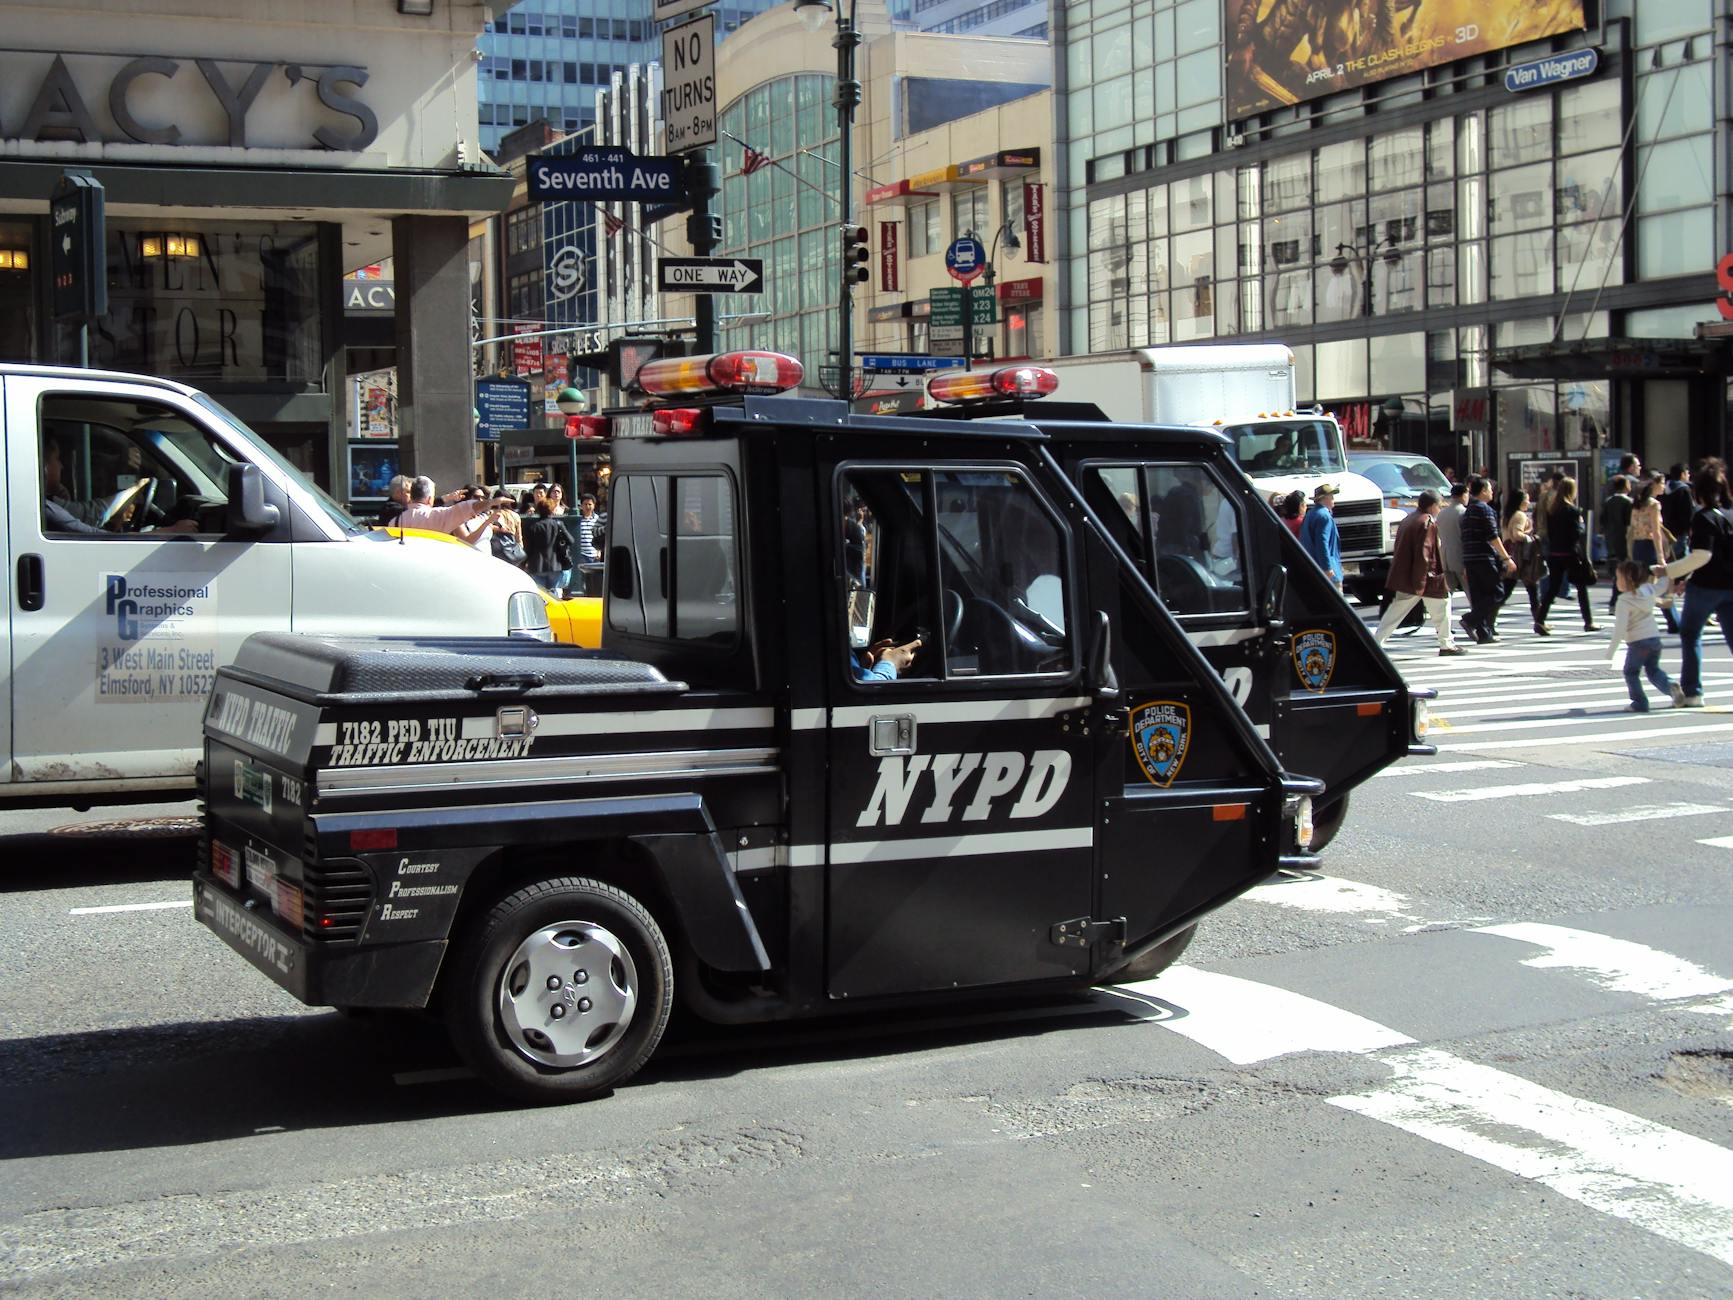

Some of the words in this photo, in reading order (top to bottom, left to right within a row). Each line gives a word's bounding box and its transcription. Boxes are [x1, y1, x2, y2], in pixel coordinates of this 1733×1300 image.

[673, 31, 702, 72] NO
[1305, 66, 1336, 85] APRIL
[1336, 63, 1345, 76] 2
[1345, 57, 1367, 73] THE
[1367, 46, 1402, 67] CLASH
[1404, 35, 1446, 56] BEGINS
[1455, 23, 1480, 44] 3D
[1513, 68, 1538, 86] Van
[1539, 54, 1592, 79] Wagner
[666, 75, 714, 116] TURNS
[582, 153, 600, 164] 461
[609, 153, 625, 164] 441
[538, 166, 625, 190] Seventh
[630, 169, 671, 190] Ave
[673, 267, 704, 283] ONE
[717, 268, 748, 284] WAY
[891, 359, 907, 367] BUS
[916, 359, 937, 367] LANE
[611, 415, 630, 437] NYPD
[106, 574, 209, 616] Professional
[117, 599, 194, 641] Graphics
[101, 646, 109, 671] 3
[112, 646, 143, 670] West
[147, 646, 175, 670] Main
[178, 647, 215, 671] Street
[99, 673, 155, 698] Elmsford,
[159, 674, 176, 695] NY
[218, 691, 251, 736] NYPD
[247, 700, 298, 755] TRAFFIC
[1134, 714, 1187, 733] DEPARTMENT
[1144, 705, 1177, 717] POLICE
[342, 719, 382, 745] 7182
[387, 718, 422, 743] PED
[427, 717, 457, 742] TIU
[328, 741, 404, 767] TRAFFIC
[406, 736, 535, 763] ENFORCEMENT
[1136, 742, 1149, 763] CITY
[1146, 763, 1157, 775] OF
[1165, 758, 1180, 777] NEW
[1176, 732, 1187, 756] YORK
[281, 775, 302, 807] 7182
[856, 749, 1073, 828] NYPD
[397, 857, 440, 875] COURTESY
[388, 880, 459, 898] PROFESSIONALISM
[380, 903, 419, 921] RESPECT
[215, 898, 276, 965] INTERCEPTOR
